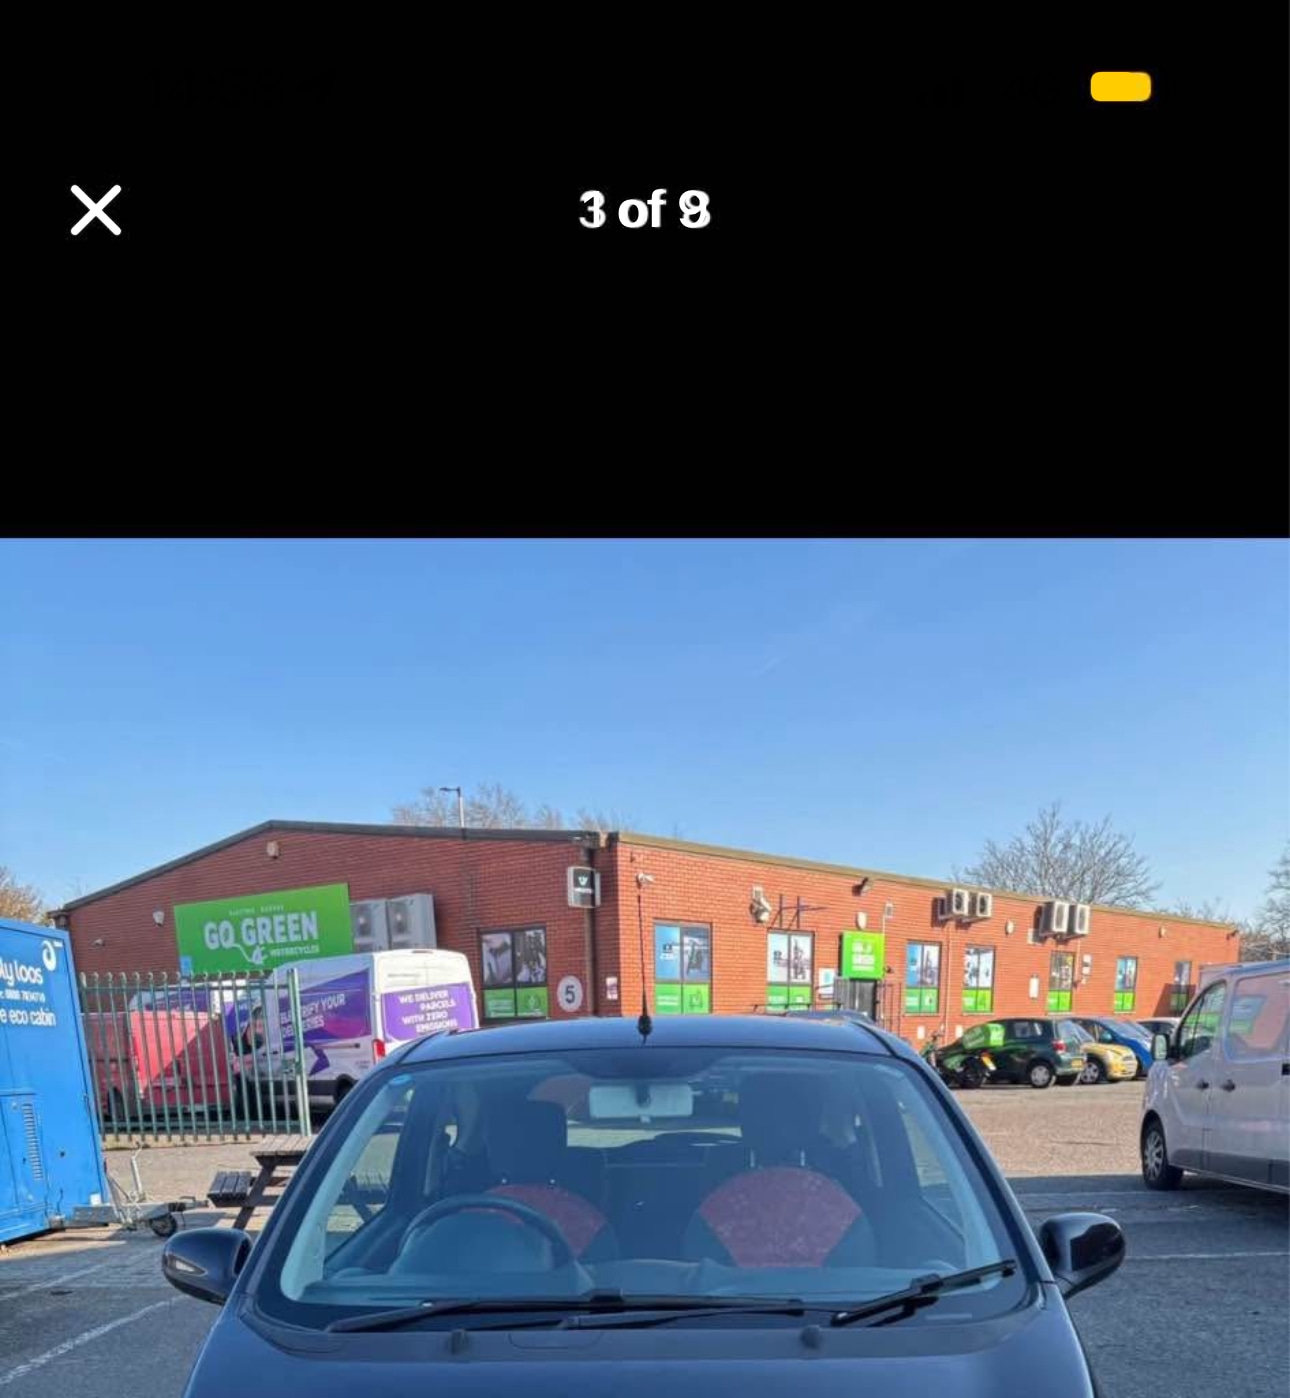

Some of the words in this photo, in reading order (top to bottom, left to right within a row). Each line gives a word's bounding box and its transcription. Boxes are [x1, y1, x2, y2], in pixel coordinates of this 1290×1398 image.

[203, 920, 235, 950] GO
[240, 911, 318, 945] GREEN
[14, 960, 43, 985] loos
[321, 993, 347, 1010] YOUR
[398, 994, 414, 1003] WE
[415, 990, 449, 1002] DELIVER
[564, 985, 576, 1004] 5
[420, 998, 456, 1010] PARCELS
[9, 1009, 28, 1024] eco
[30, 1007, 56, 1027] cabin
[402, 1015, 425, 1024] WITH
[426, 1012, 448, 1021] ZERO
[416, 1019, 458, 1033] EMISSIONS
